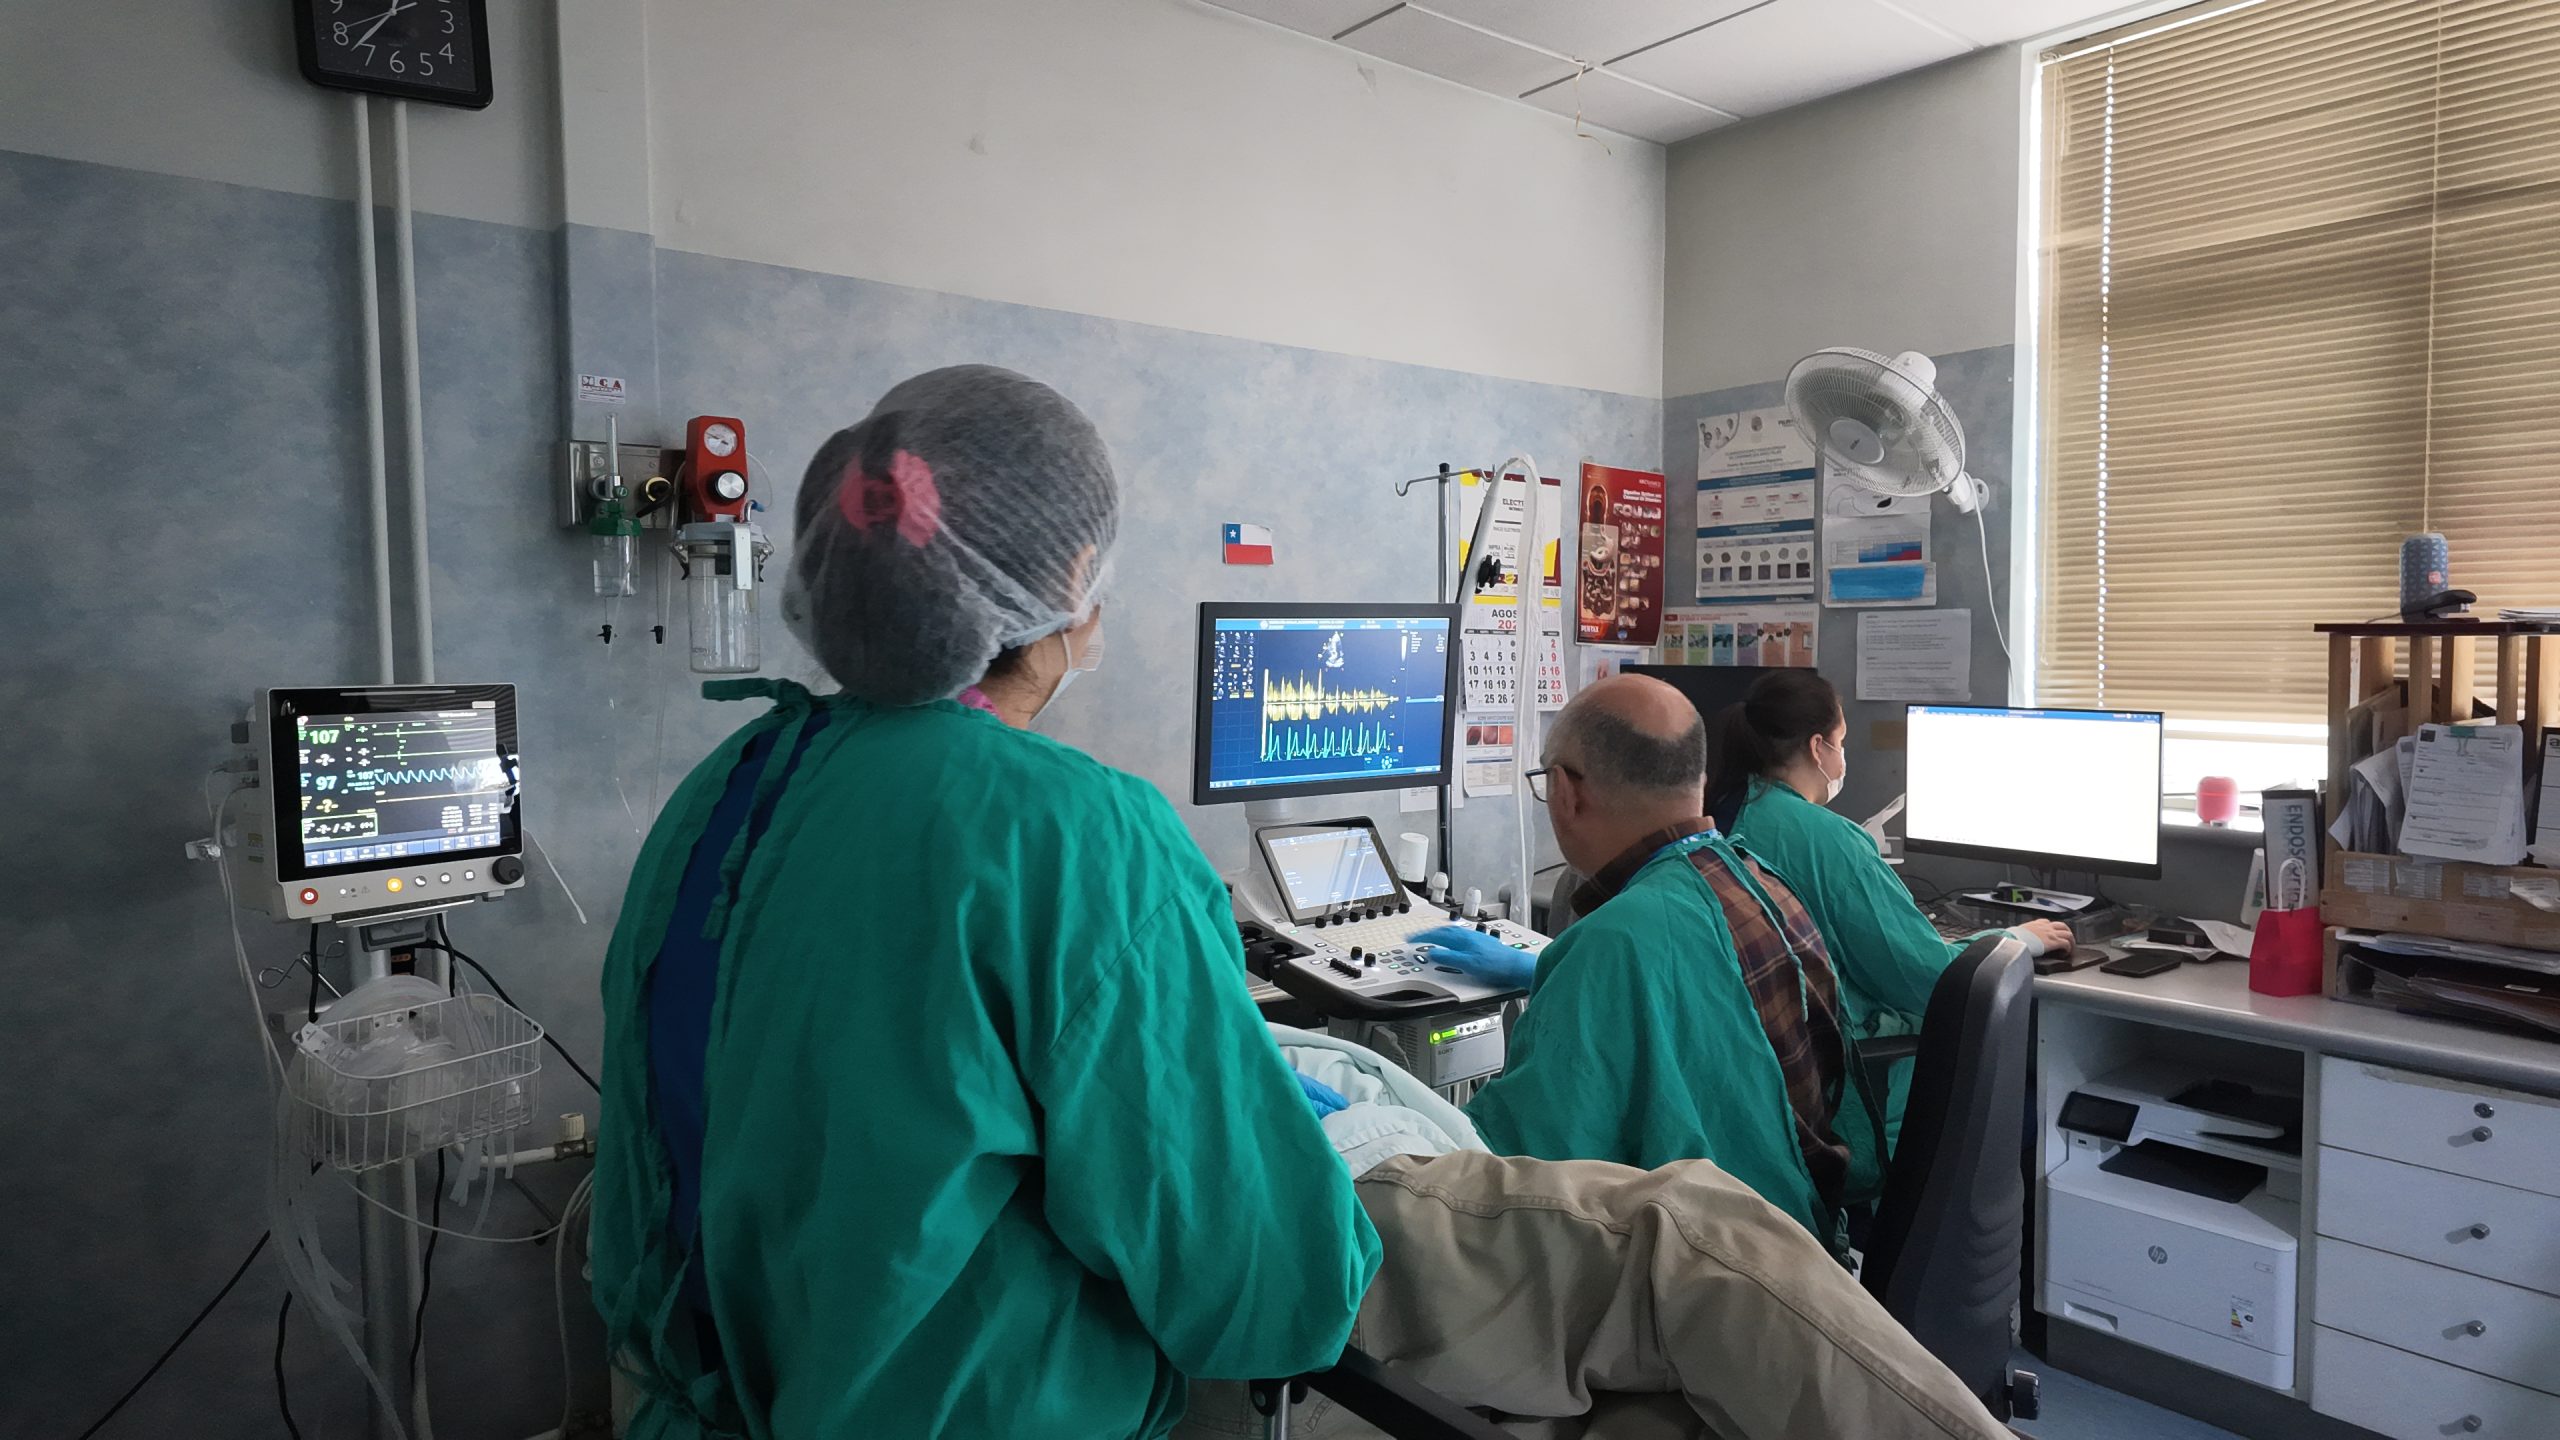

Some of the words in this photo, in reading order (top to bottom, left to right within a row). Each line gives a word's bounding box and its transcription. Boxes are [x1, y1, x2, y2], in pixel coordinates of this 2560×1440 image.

[440, 10, 455, 34] 3
[333, 21, 349, 46] 8
[360, 42, 376, 67] 7
[438, 42, 455, 64] 4
[389, 50, 405, 73] 6
[419, 52, 434, 76] 5
[1551, 639, 1556, 649] 2
[1470, 651, 1476, 661] 3
[1484, 651, 1489, 661] 4
[1497, 652, 1503, 661] 5
[1551, 652, 1557, 662] 9
[1468, 666, 1479, 675] 10
[1483, 666, 1492, 675] 11
[1496, 666, 1506, 675] 12
[1550, 666, 1560, 676] 16
[1469, 680, 1479, 690] 17
[1484, 680, 1493, 690] 18
[1497, 680, 1507, 690] 19
[1537, 680, 1547, 690] 22
[1550, 680, 1561, 690] 23
[1484, 694, 1495, 704] 25
[1498, 694, 1508, 704] 26
[1537, 694, 1548, 704] 29
[1551, 694, 1563, 704] 30
[309, 729, 340, 745] 107
[315, 775, 338, 791] 97
